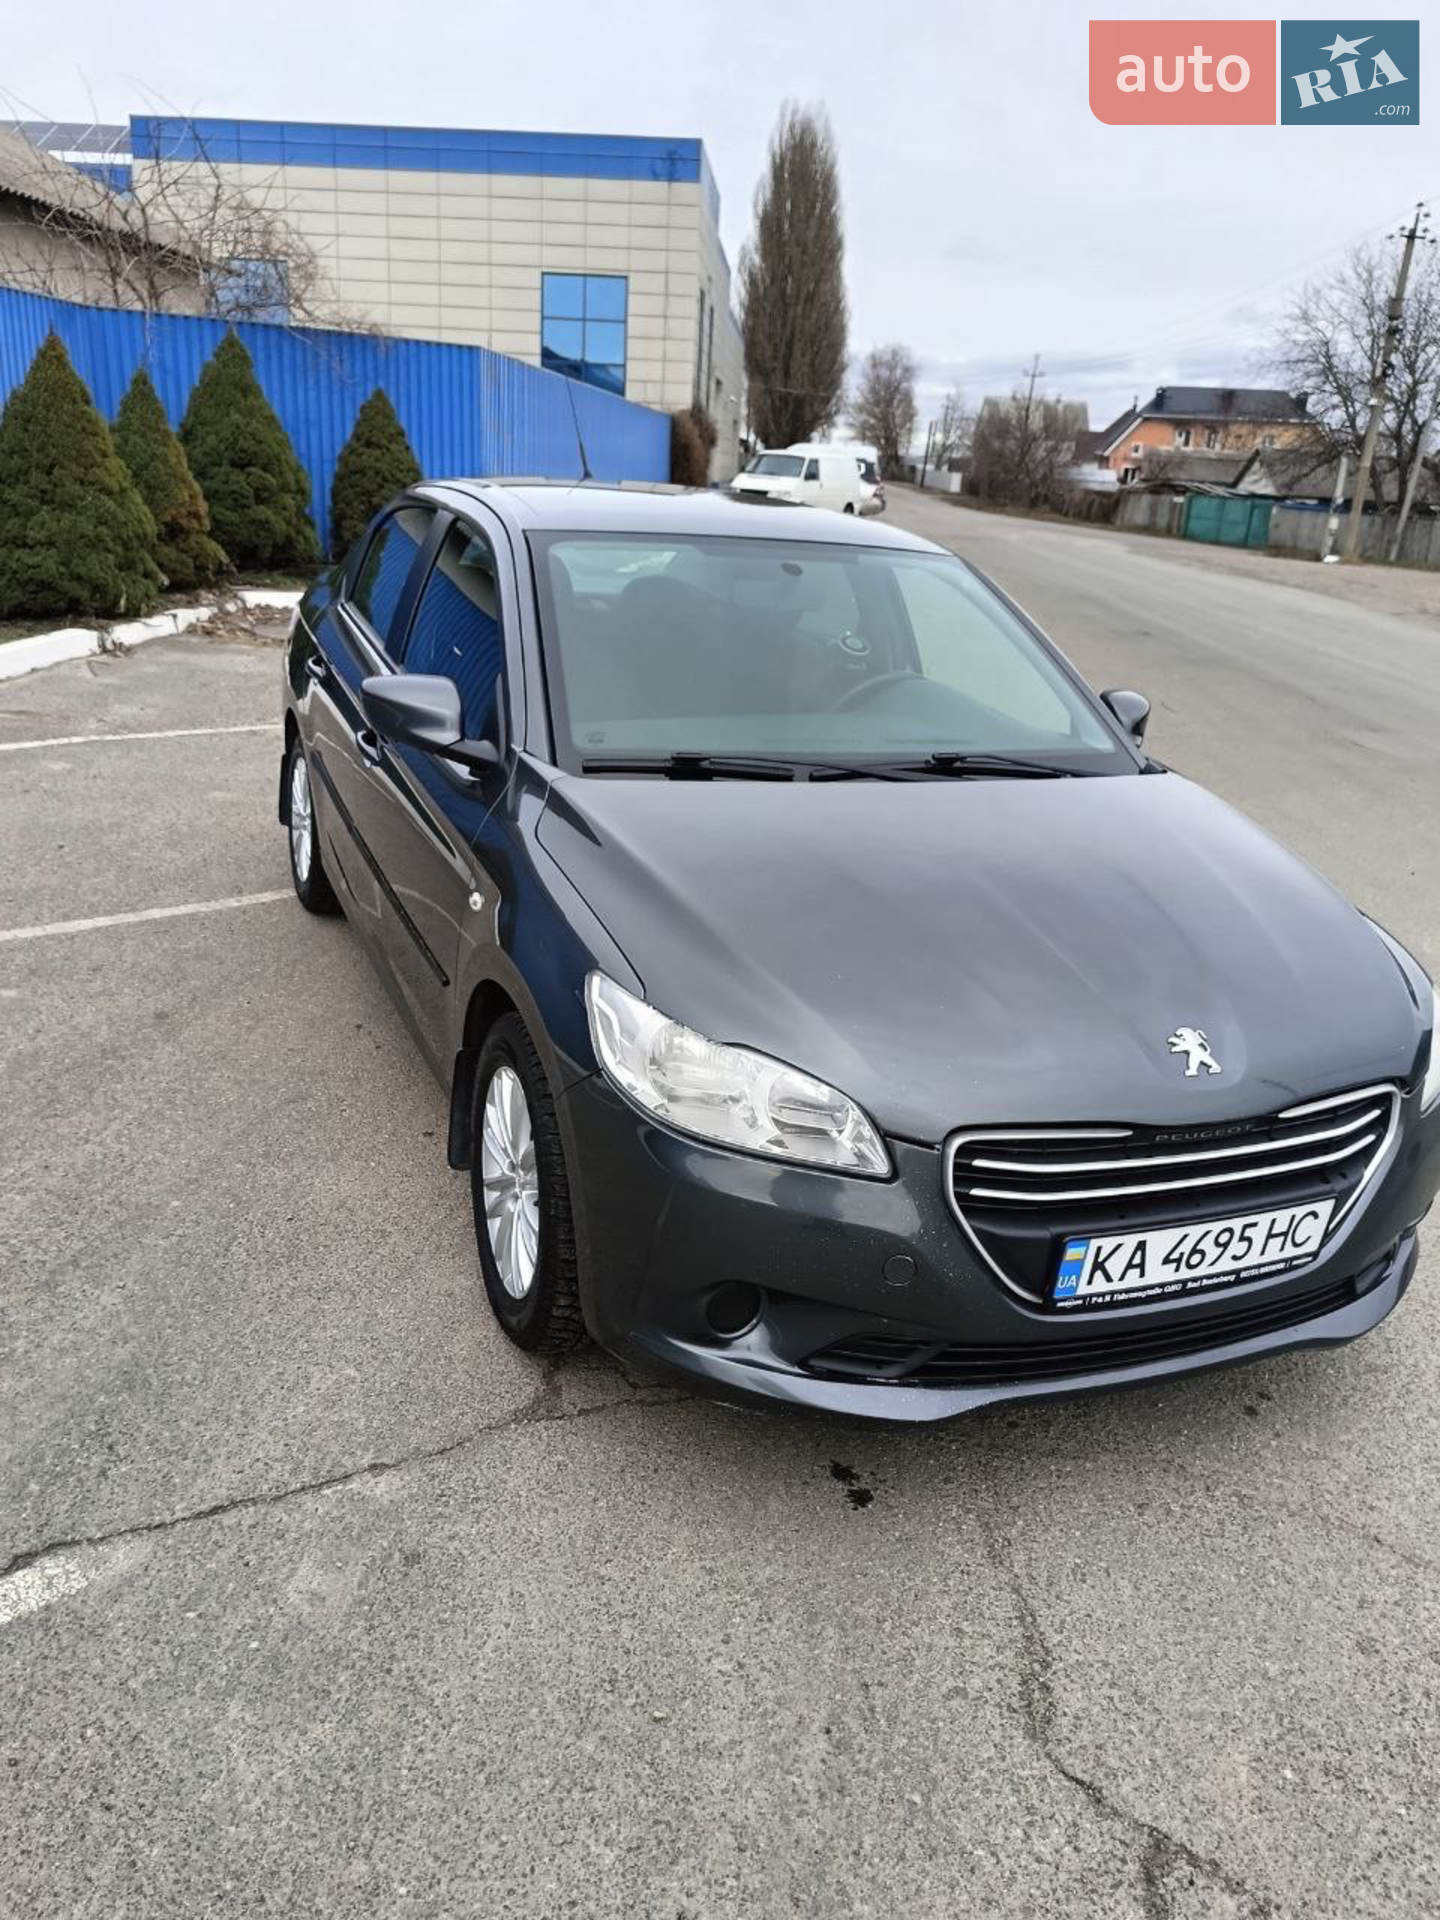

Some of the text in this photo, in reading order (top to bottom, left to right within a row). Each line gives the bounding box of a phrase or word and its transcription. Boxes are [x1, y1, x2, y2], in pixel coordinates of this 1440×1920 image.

[1086, 1210, 1320, 1286] KA 4695 HC
[1057, 1275, 1077, 1289] UA
